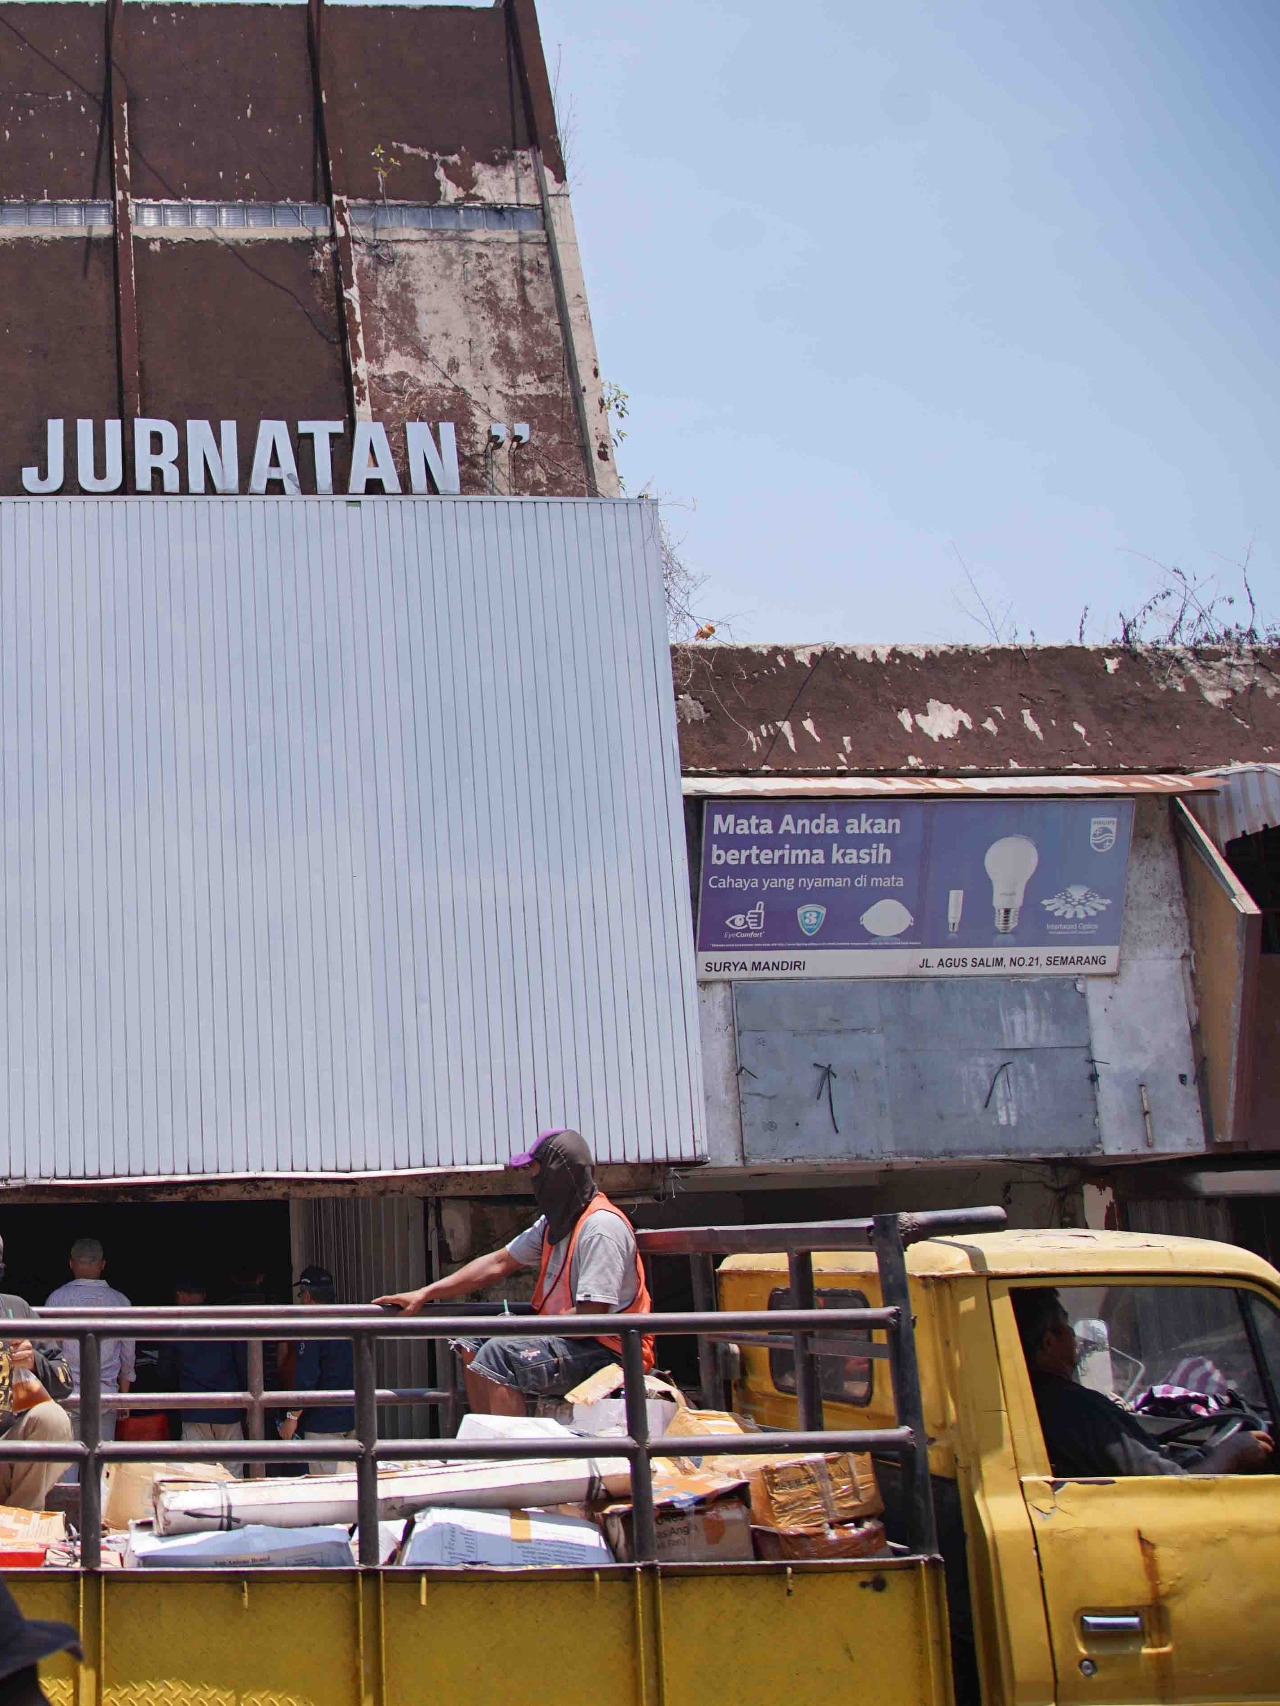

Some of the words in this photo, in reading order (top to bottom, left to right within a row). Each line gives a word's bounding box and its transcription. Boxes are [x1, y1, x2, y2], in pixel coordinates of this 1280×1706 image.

[21, 416, 461, 495] JURNATAN
[713, 813, 773, 835] Mata
[778, 813, 840, 835] Anda
[845, 813, 901, 834] akan
[711, 844, 826, 865] berterima
[831, 843, 892, 864] kasih
[708, 875, 759, 890] Cahaya
[762, 877, 795, 890] yang
[798, 877, 851, 890] nyaman
[854, 874, 867, 887] di
[870, 875, 904, 887] mata
[705, 961, 748, 973] SURYA
[751, 960, 806, 972] MANDIRI
[918, 959, 935, 969] JL.
[937, 957, 968, 968] AGUS
[970, 956, 1006, 969] SALIM,
[1009, 956, 1043, 968] NO.21,
[1045, 955, 1107, 967] SEMARANG
